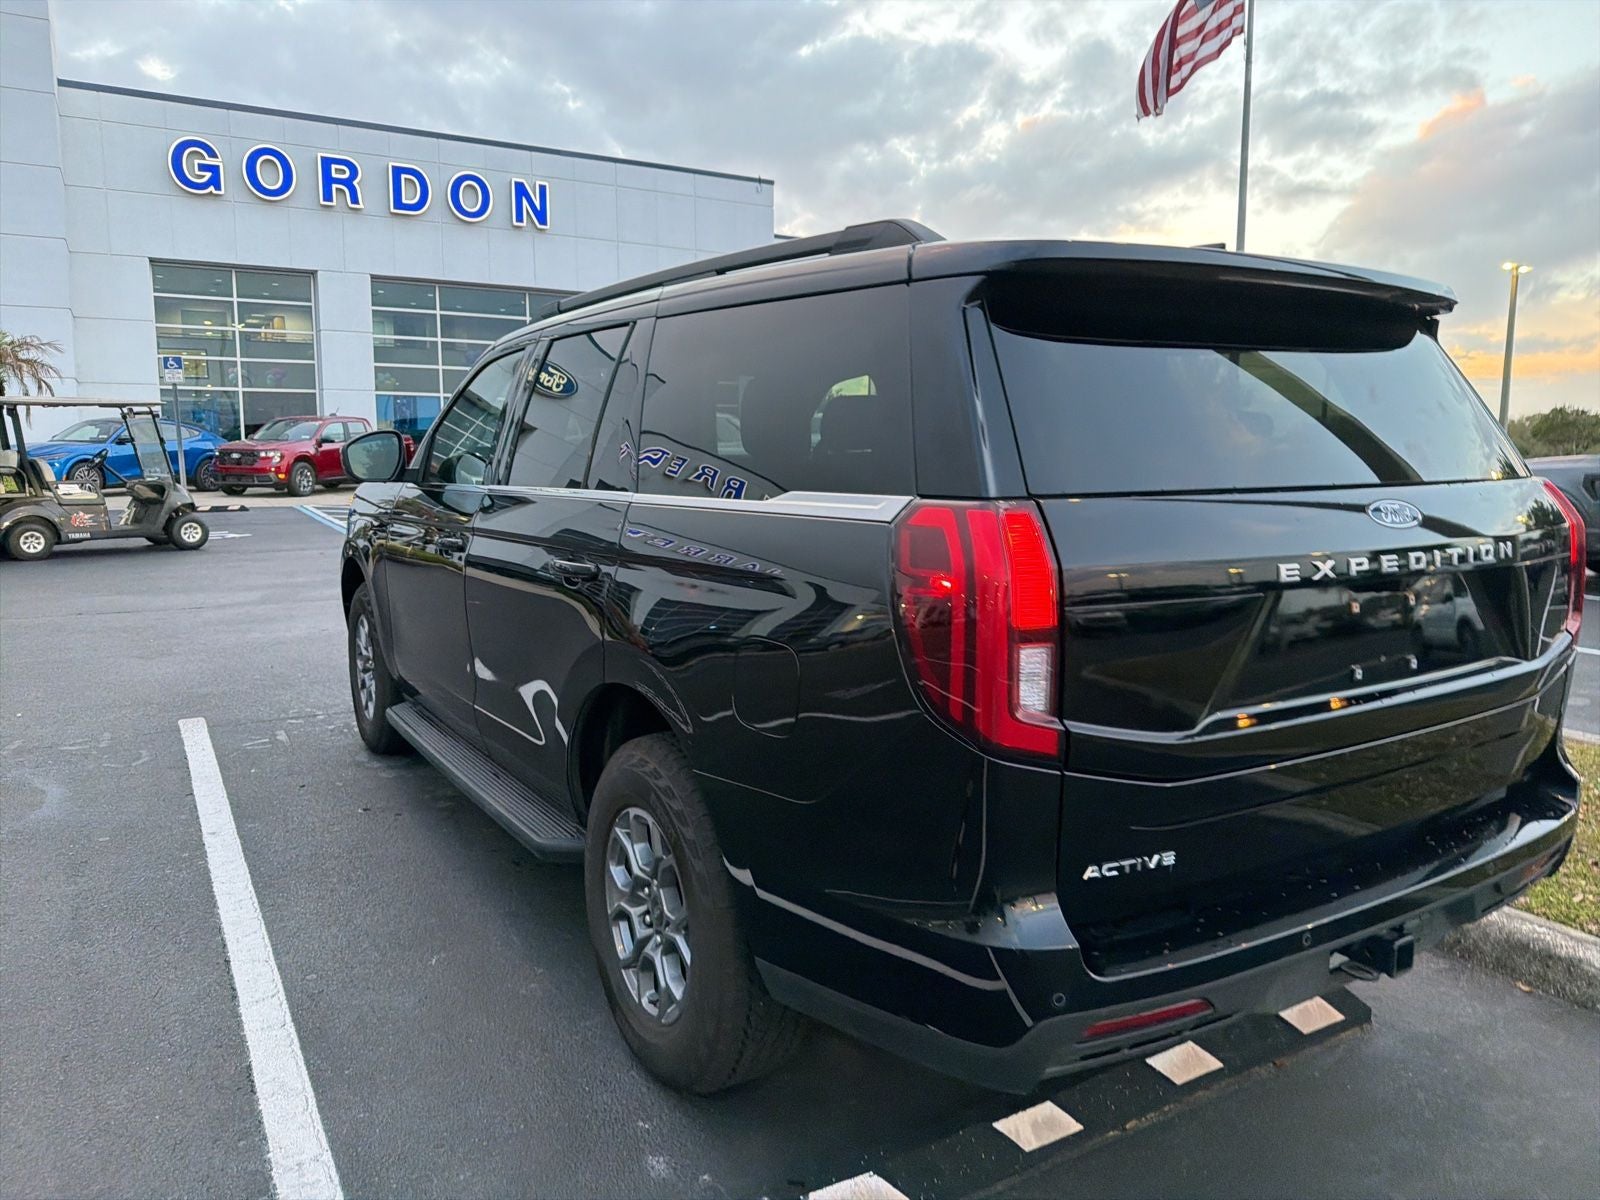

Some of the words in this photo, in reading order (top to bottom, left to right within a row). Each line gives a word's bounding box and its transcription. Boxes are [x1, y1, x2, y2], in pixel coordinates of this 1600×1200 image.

[168, 136, 550, 230] GORDON
[1377, 501, 1415, 524] Ford
[68, 532, 91, 540] YAMAHA
[1277, 541, 1513, 583] EXPEDITION
[1082, 851, 1176, 881] ACTIVE
